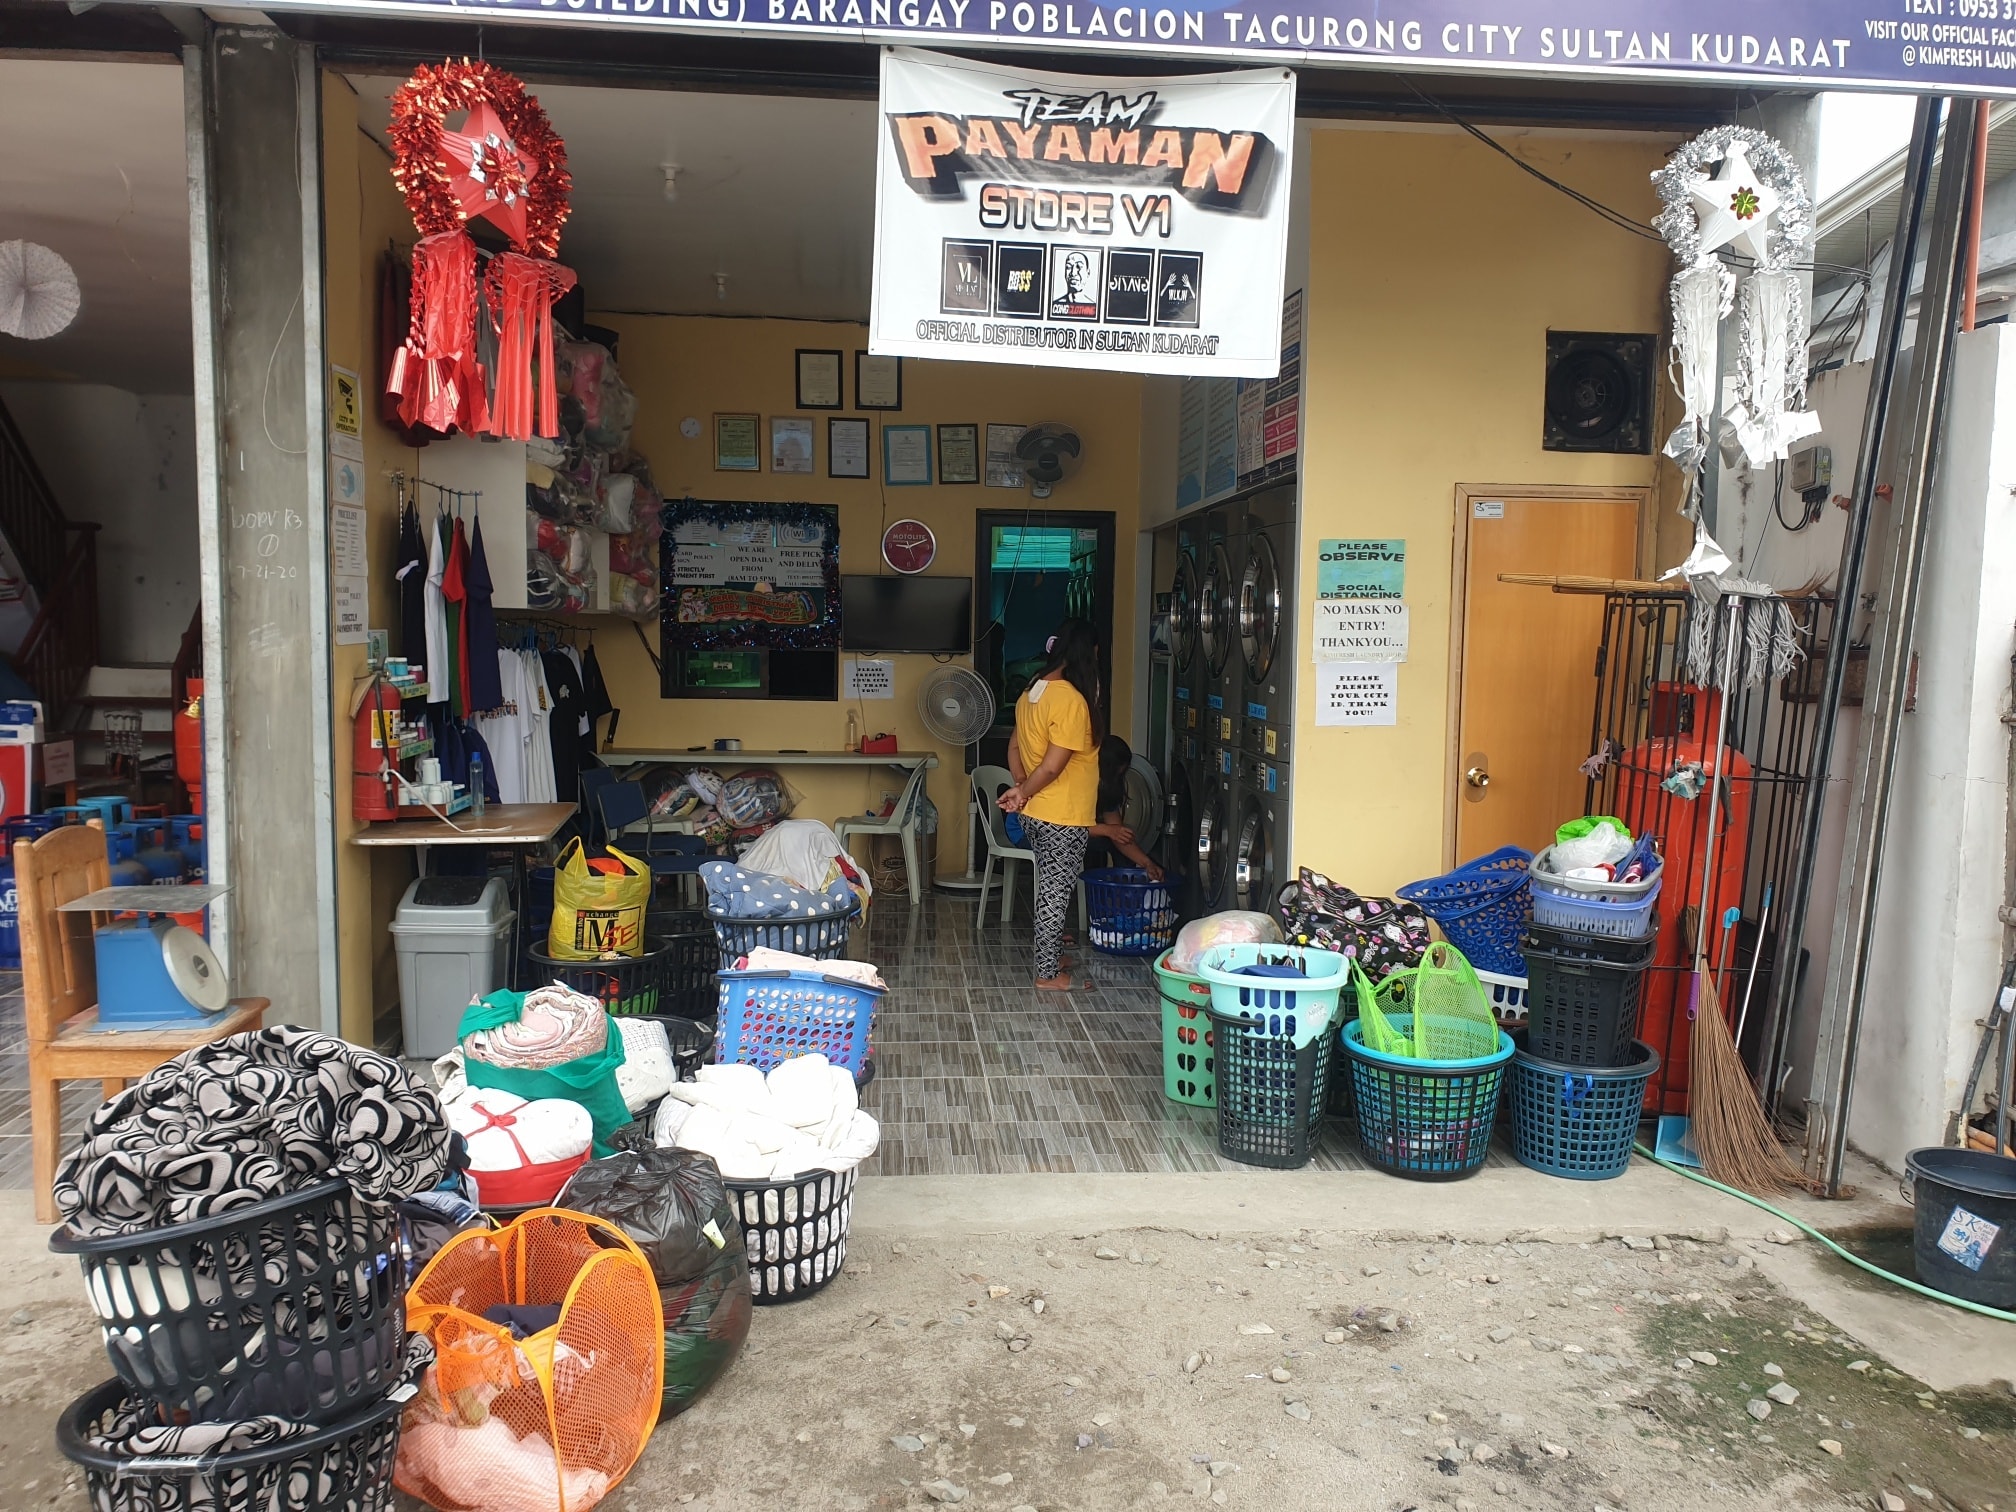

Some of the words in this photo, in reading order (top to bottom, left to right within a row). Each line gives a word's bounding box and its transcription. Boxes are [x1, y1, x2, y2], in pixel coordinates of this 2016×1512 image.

[1959, 0, 1998, 19] 0953
[768, 0, 969, 29] BARANGAY
[989, 0, 1204, 40] POBLACION
[1223, 12, 1423, 51] TACURONG
[1441, 22, 1522, 56] CITY
[1540, 26, 1671, 62] SULTAN
[1691, 32, 1851, 68] KUDARAT
[1864, 20, 1898, 40] VISIT
[1900, 22, 1930, 42] OUR
[1932, 24, 1989, 45] OFFICIAL
[1991, 28, 2016, 48] FAC
[1902, 45, 1916, 67] @
[1919, 46, 1982, 68] KIMFRESH
[1003, 88, 1158, 130] TEAM
[888, 112, 1262, 200] PAYAMAN
[978, 183, 1114, 235] STORE
[1121, 193, 1173, 239] V1
[916, 320, 980, 343] OFFICIAL
[983, 324, 1076, 350] DISTRIBUTOR
[1078, 330, 1094, 350] IN
[1095, 331, 1150, 354] SULTAN
[1152, 333, 1220, 356] KUDARAT
[780, 550, 800, 558] FREE
[1319, 552, 1405, 562] OBSERVE
[1338, 543, 1388, 551] PLEASE
[1323, 605, 1341, 615] NO
[1344, 605, 1381, 615] MASK
[1384, 604, 1402, 615] NO
[1339, 621, 1386, 631] ENTRY!
